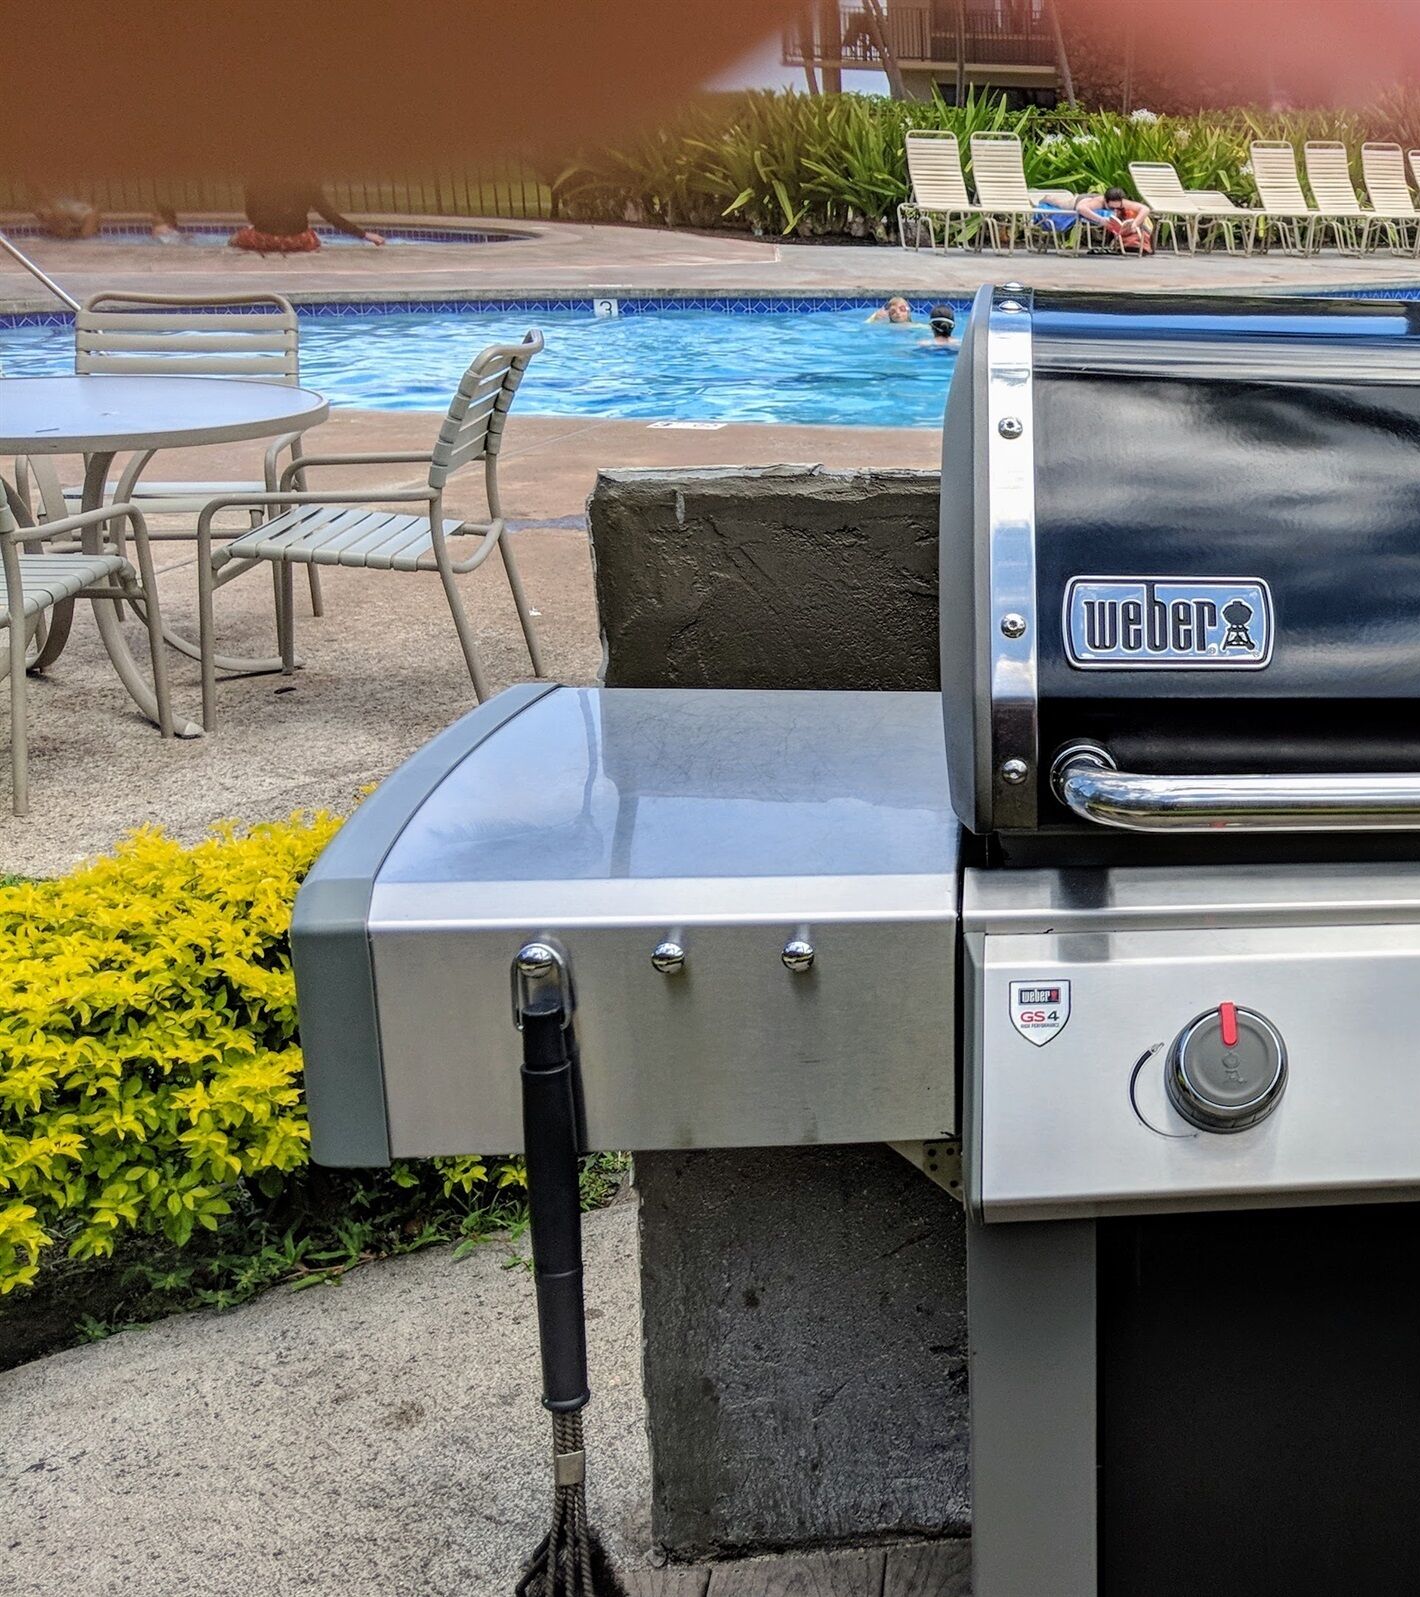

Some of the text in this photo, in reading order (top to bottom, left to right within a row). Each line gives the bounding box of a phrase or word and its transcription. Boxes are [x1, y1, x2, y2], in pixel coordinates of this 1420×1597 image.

[1083, 582, 1217, 652] weber
[1022, 988, 1050, 1003] weber
[1020, 1010, 1060, 1022] GS 4
